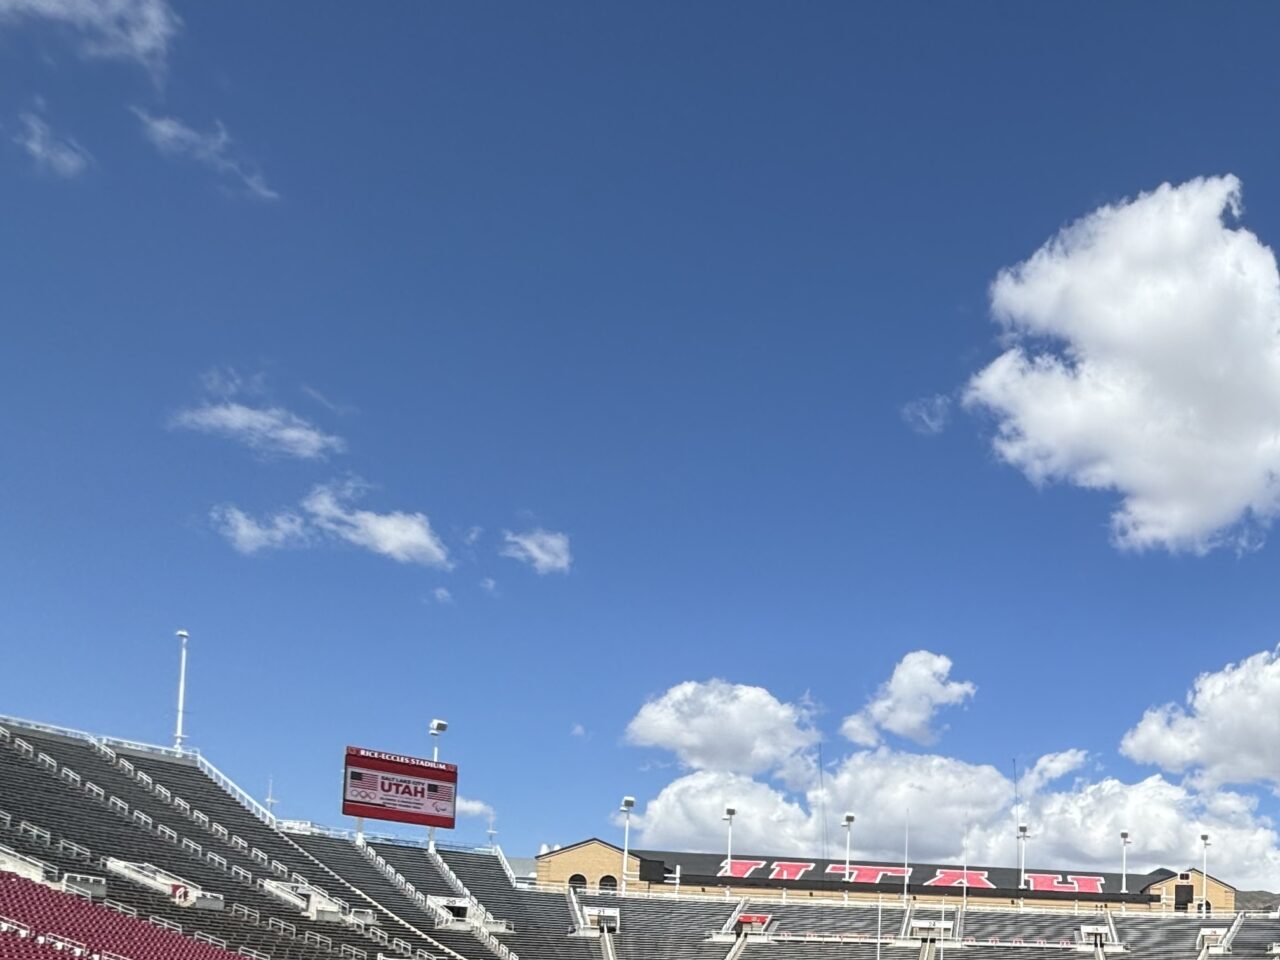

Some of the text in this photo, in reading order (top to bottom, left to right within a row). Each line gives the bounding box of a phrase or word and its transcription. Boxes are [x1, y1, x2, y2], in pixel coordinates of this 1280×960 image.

[360, 749, 446, 770] RICE-ECCLES STADIUM
[381, 780, 425, 798] UTAH
